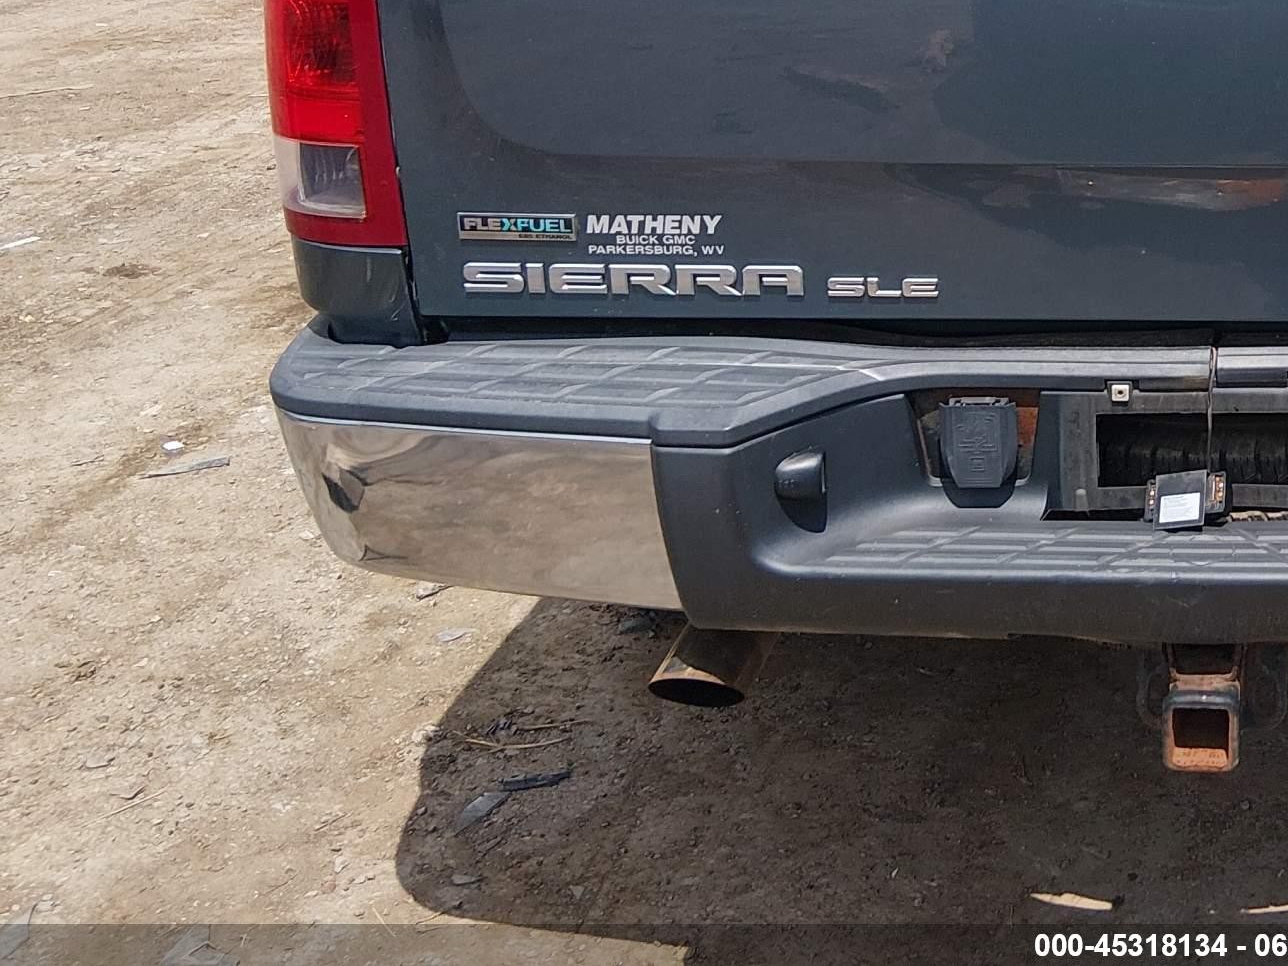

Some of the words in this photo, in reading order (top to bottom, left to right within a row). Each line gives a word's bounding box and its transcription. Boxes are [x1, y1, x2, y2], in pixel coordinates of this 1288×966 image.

[462, 217, 572, 233] FLEXFUEL
[585, 214, 722, 234] MATHENY
[616, 235, 659, 245] BUICK
[662, 235, 696, 245] GMC
[588, 245, 698, 256] PARKERSBURG,
[701, 245, 725, 255] WV
[463, 262, 804, 297] SIERRA
[827, 277, 939, 298] SLE
